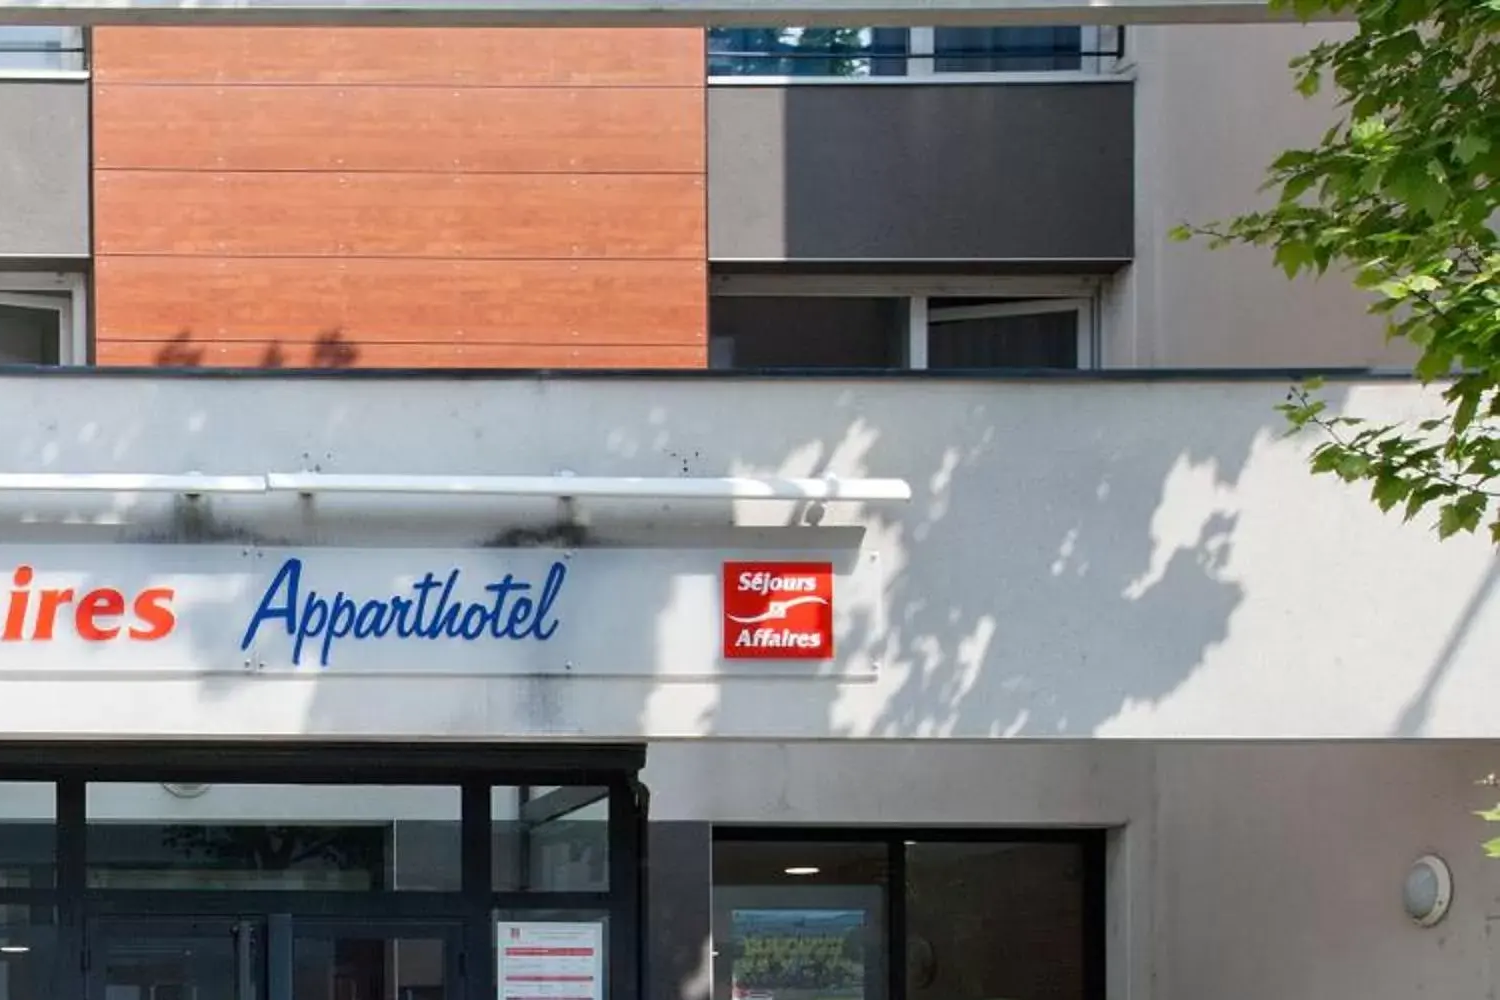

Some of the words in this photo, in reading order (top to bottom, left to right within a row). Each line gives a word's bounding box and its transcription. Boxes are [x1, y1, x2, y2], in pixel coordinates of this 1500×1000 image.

[737, 571, 817, 595] Séjours
[240, 553, 569, 667] Apparthotel
[735, 627, 821, 648] Affaires
